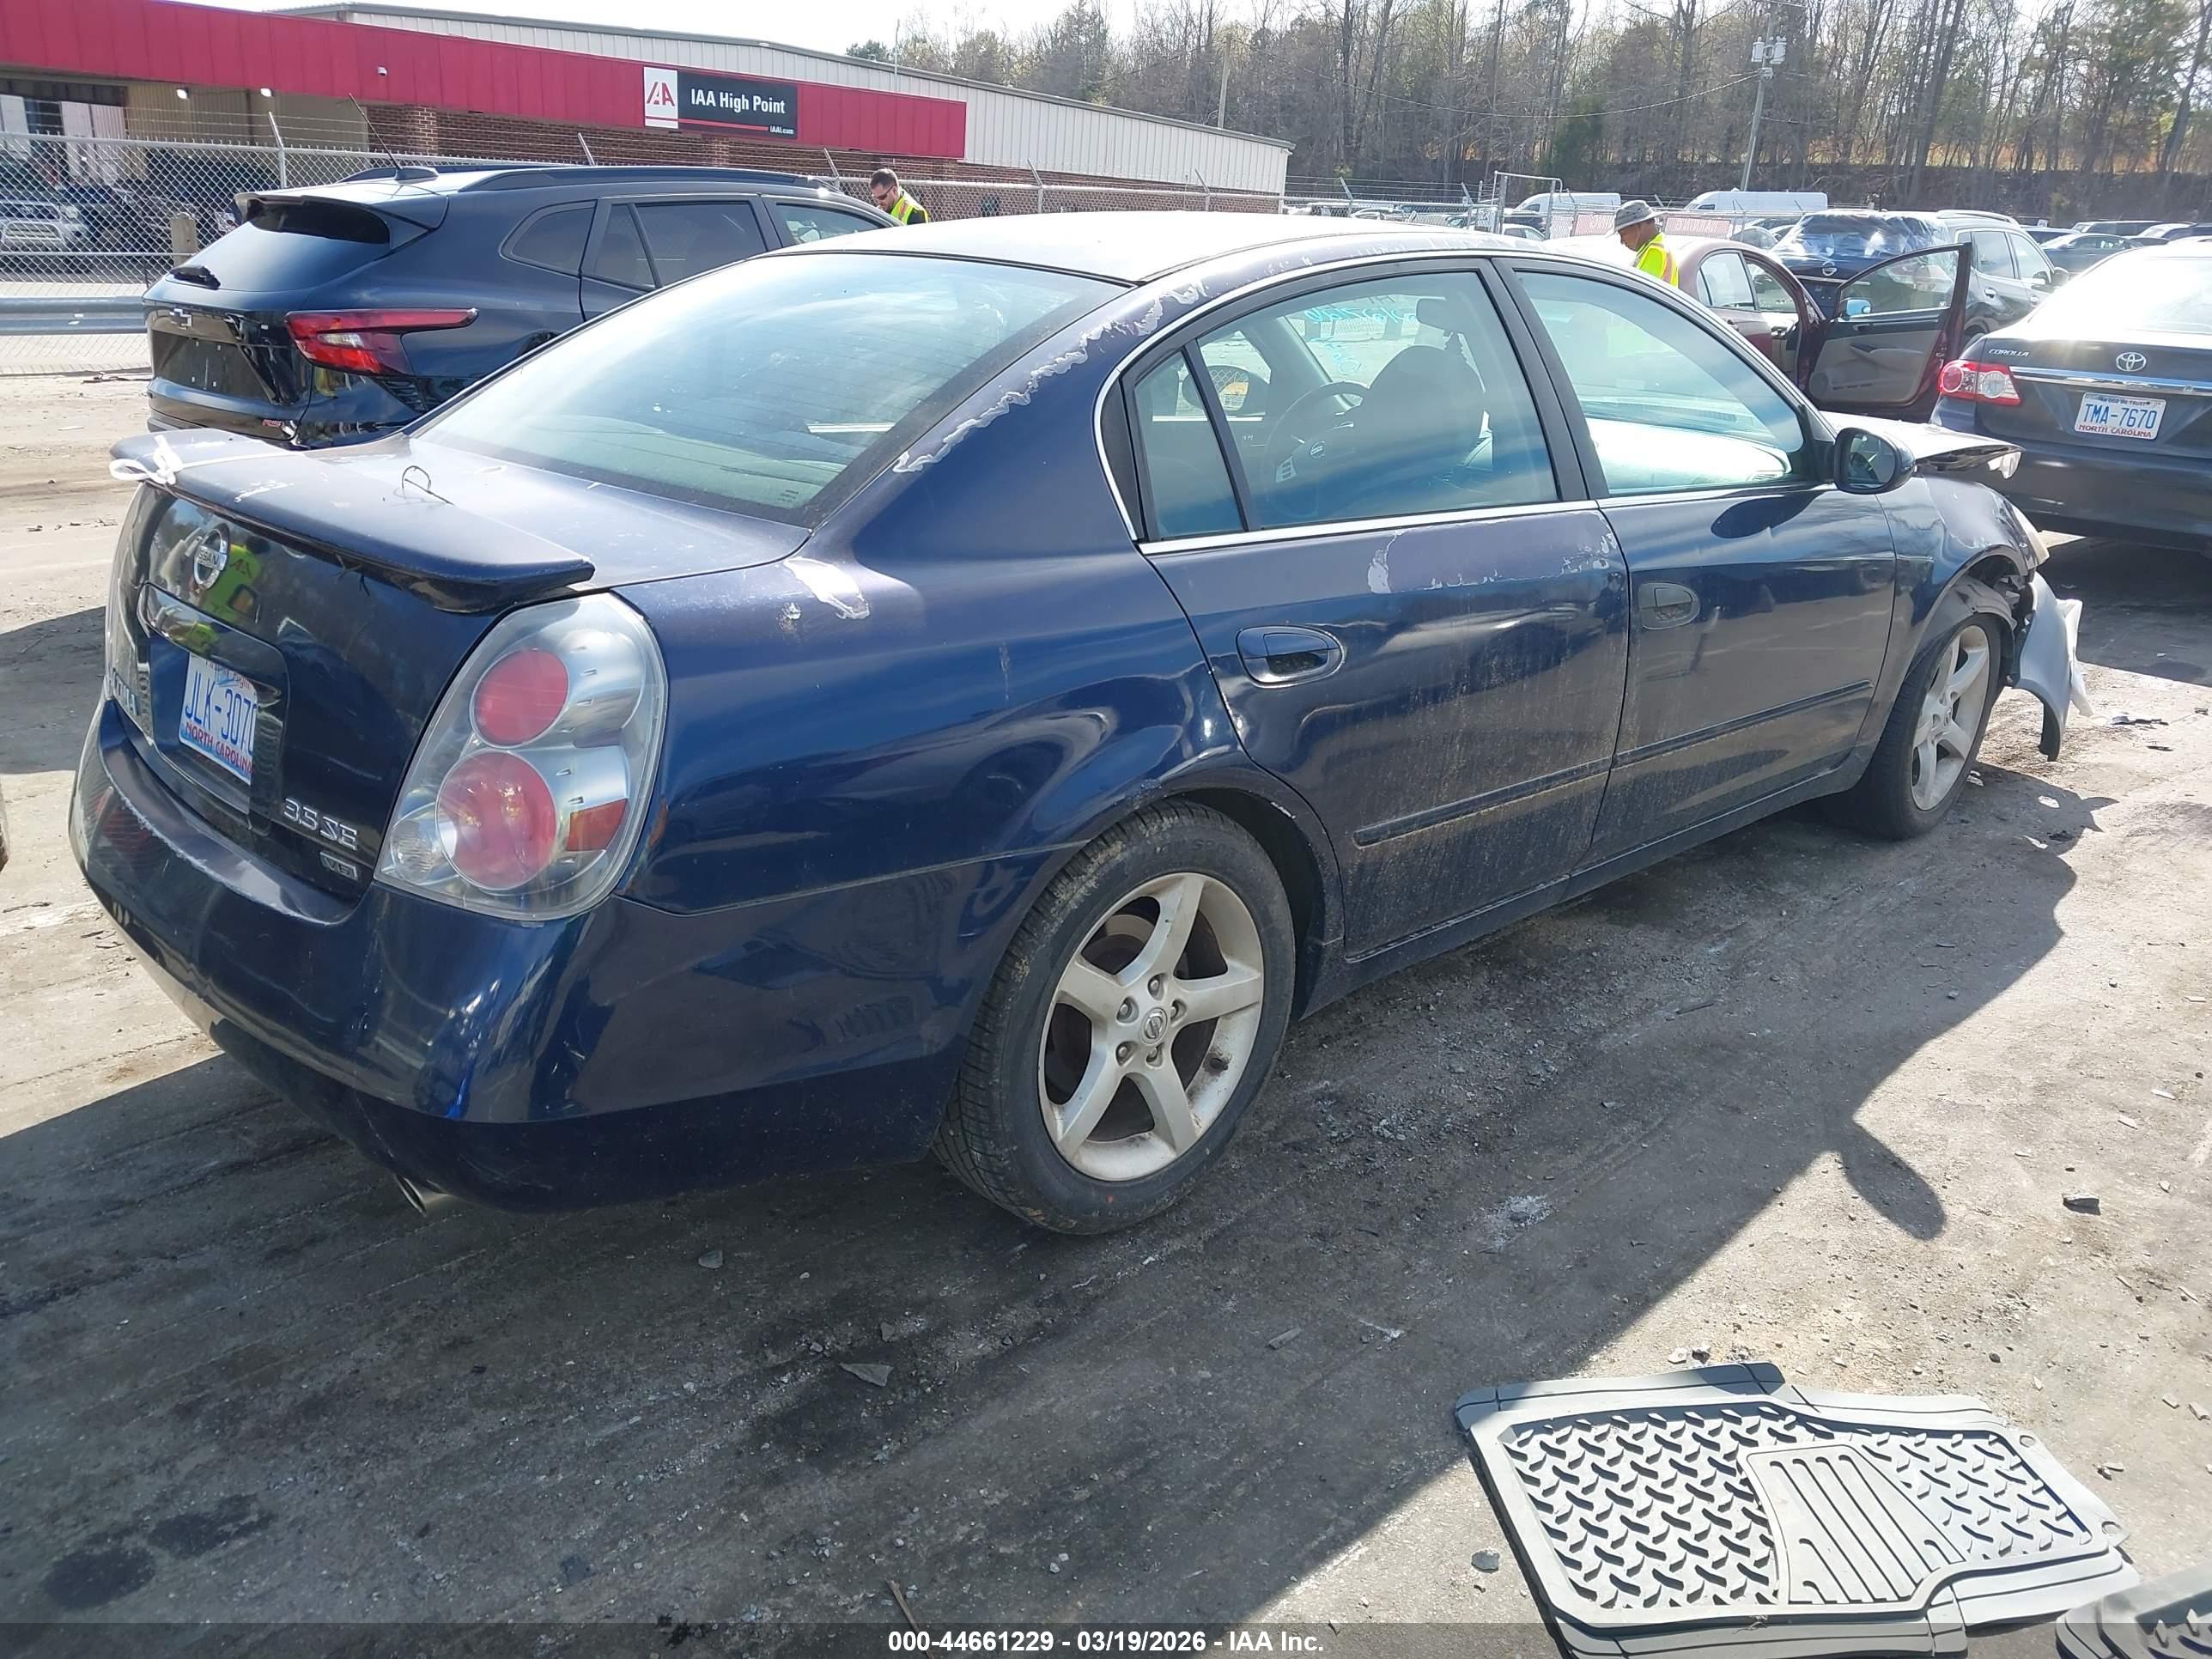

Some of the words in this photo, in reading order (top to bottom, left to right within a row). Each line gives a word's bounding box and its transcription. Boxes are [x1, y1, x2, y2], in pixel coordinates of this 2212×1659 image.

[690, 88, 716, 107] IAA
[720, 91, 750, 113] High
[752, 94, 786, 114] Point
[1988, 348, 2031, 357] COROLLA
[2082, 404, 2158, 429] TMA-7670
[2078, 423, 2108, 434] NORTH
[2110, 428, 2153, 439] CAROLINA
[185, 720, 214, 750] NORTH
[319, 816, 358, 852] SE
